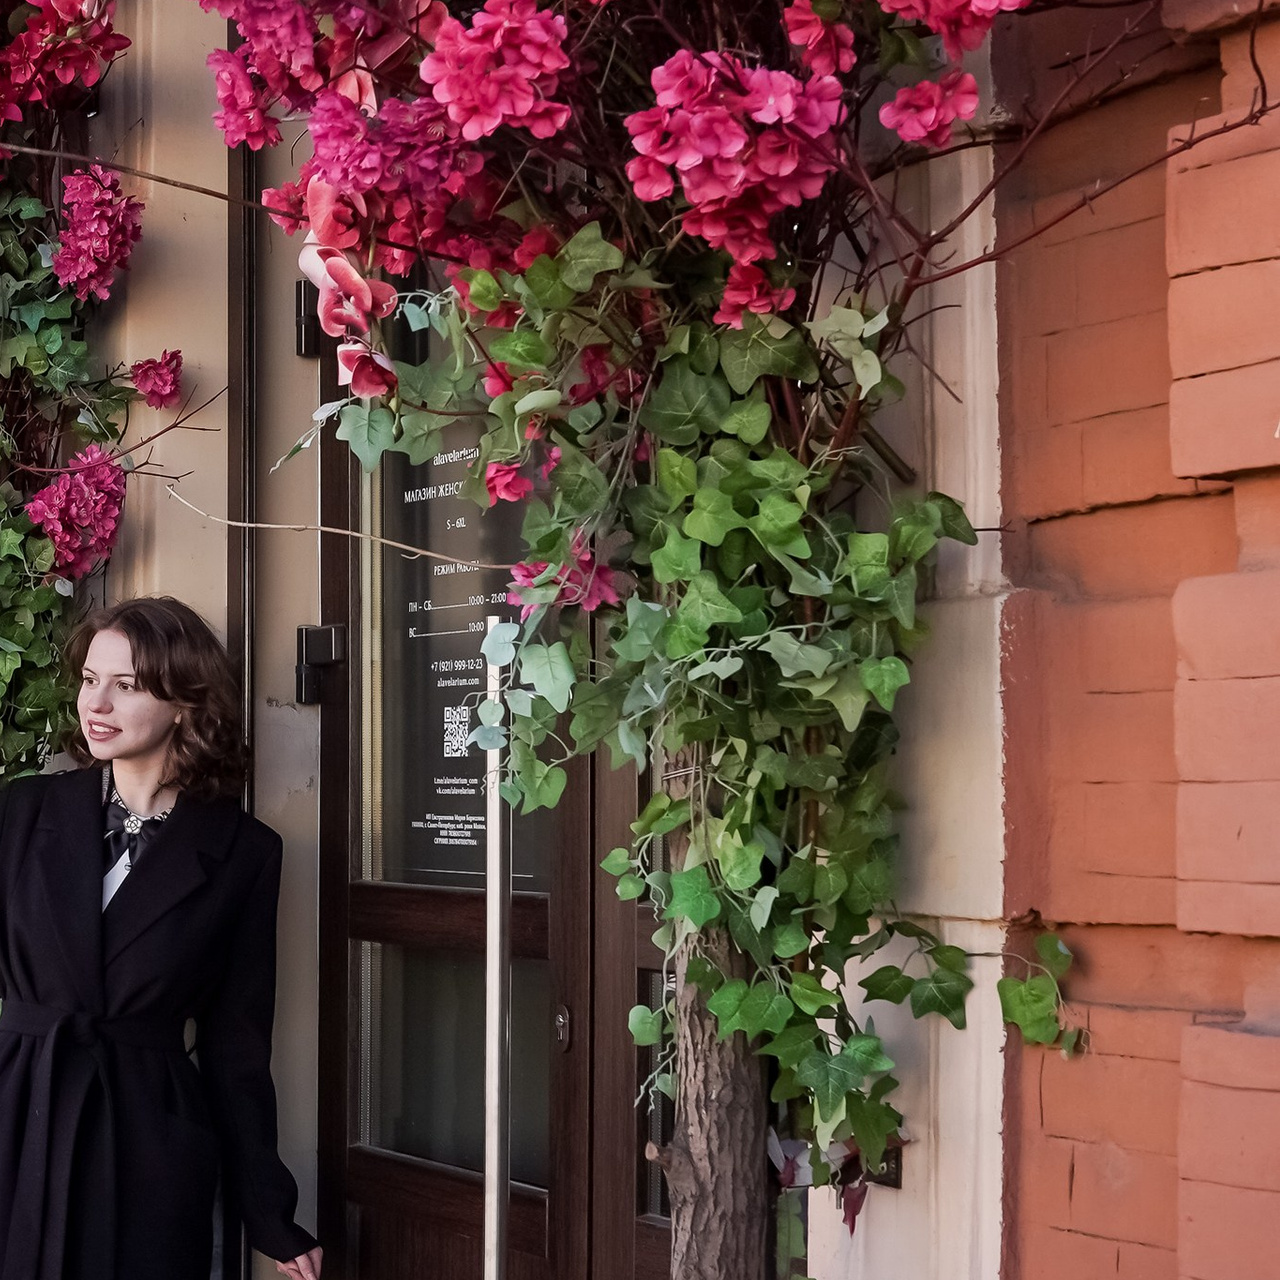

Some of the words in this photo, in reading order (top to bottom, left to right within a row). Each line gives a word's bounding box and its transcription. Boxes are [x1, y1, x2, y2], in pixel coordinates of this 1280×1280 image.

[404, 485, 437, 503] МАГАЗИН
[446, 519, 451, 530] S
[433, 564, 455, 576] РЕЖИМ
[408, 602, 418, 612] ПН
[468, 595, 484, 606] 10:00
[491, 592, 507, 603] 21:00
[468, 622, 484, 632] 10:00
[431, 661, 438, 672] +7
[439, 660, 453, 672] (921)
[454, 659, 483, 671] 999-12-23
[437, 677, 480, 687] alavelarium.com
